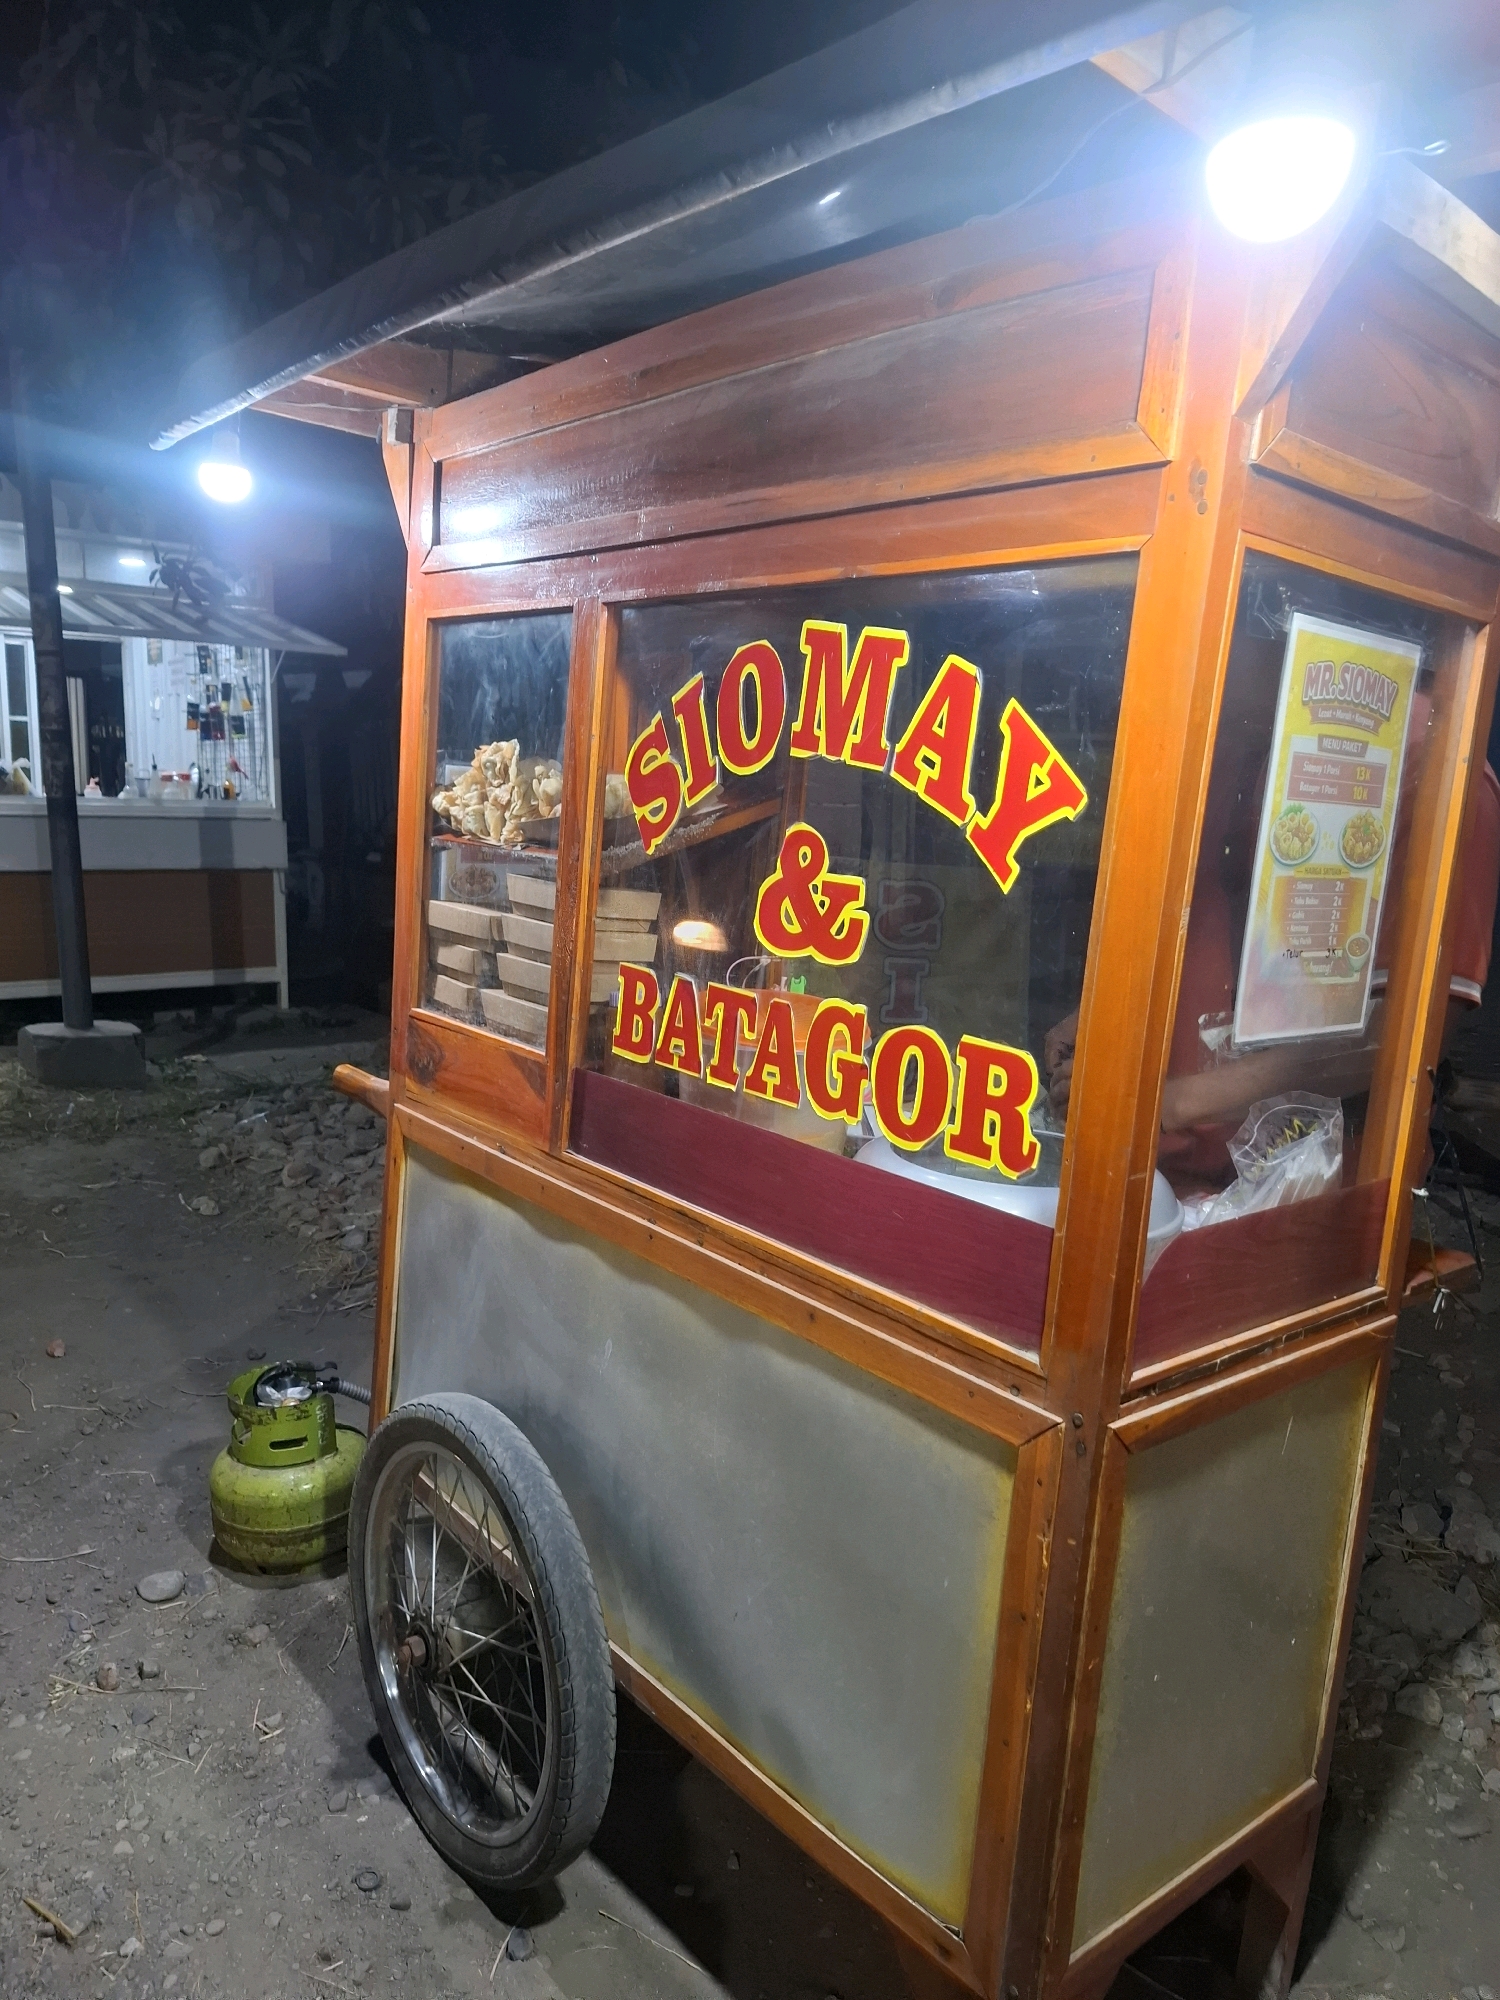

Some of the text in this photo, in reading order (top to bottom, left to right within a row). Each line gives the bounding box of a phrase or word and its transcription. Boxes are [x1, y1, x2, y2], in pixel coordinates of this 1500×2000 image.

[625, 620, 1088, 894] SIOMAY
[1302, 660, 1398, 718] MR. SIOMAY
[1322, 738, 1363, 753] MENU PAKET
[754, 822, 869, 965] &
[612, 962, 1041, 1179] BATAGOR
